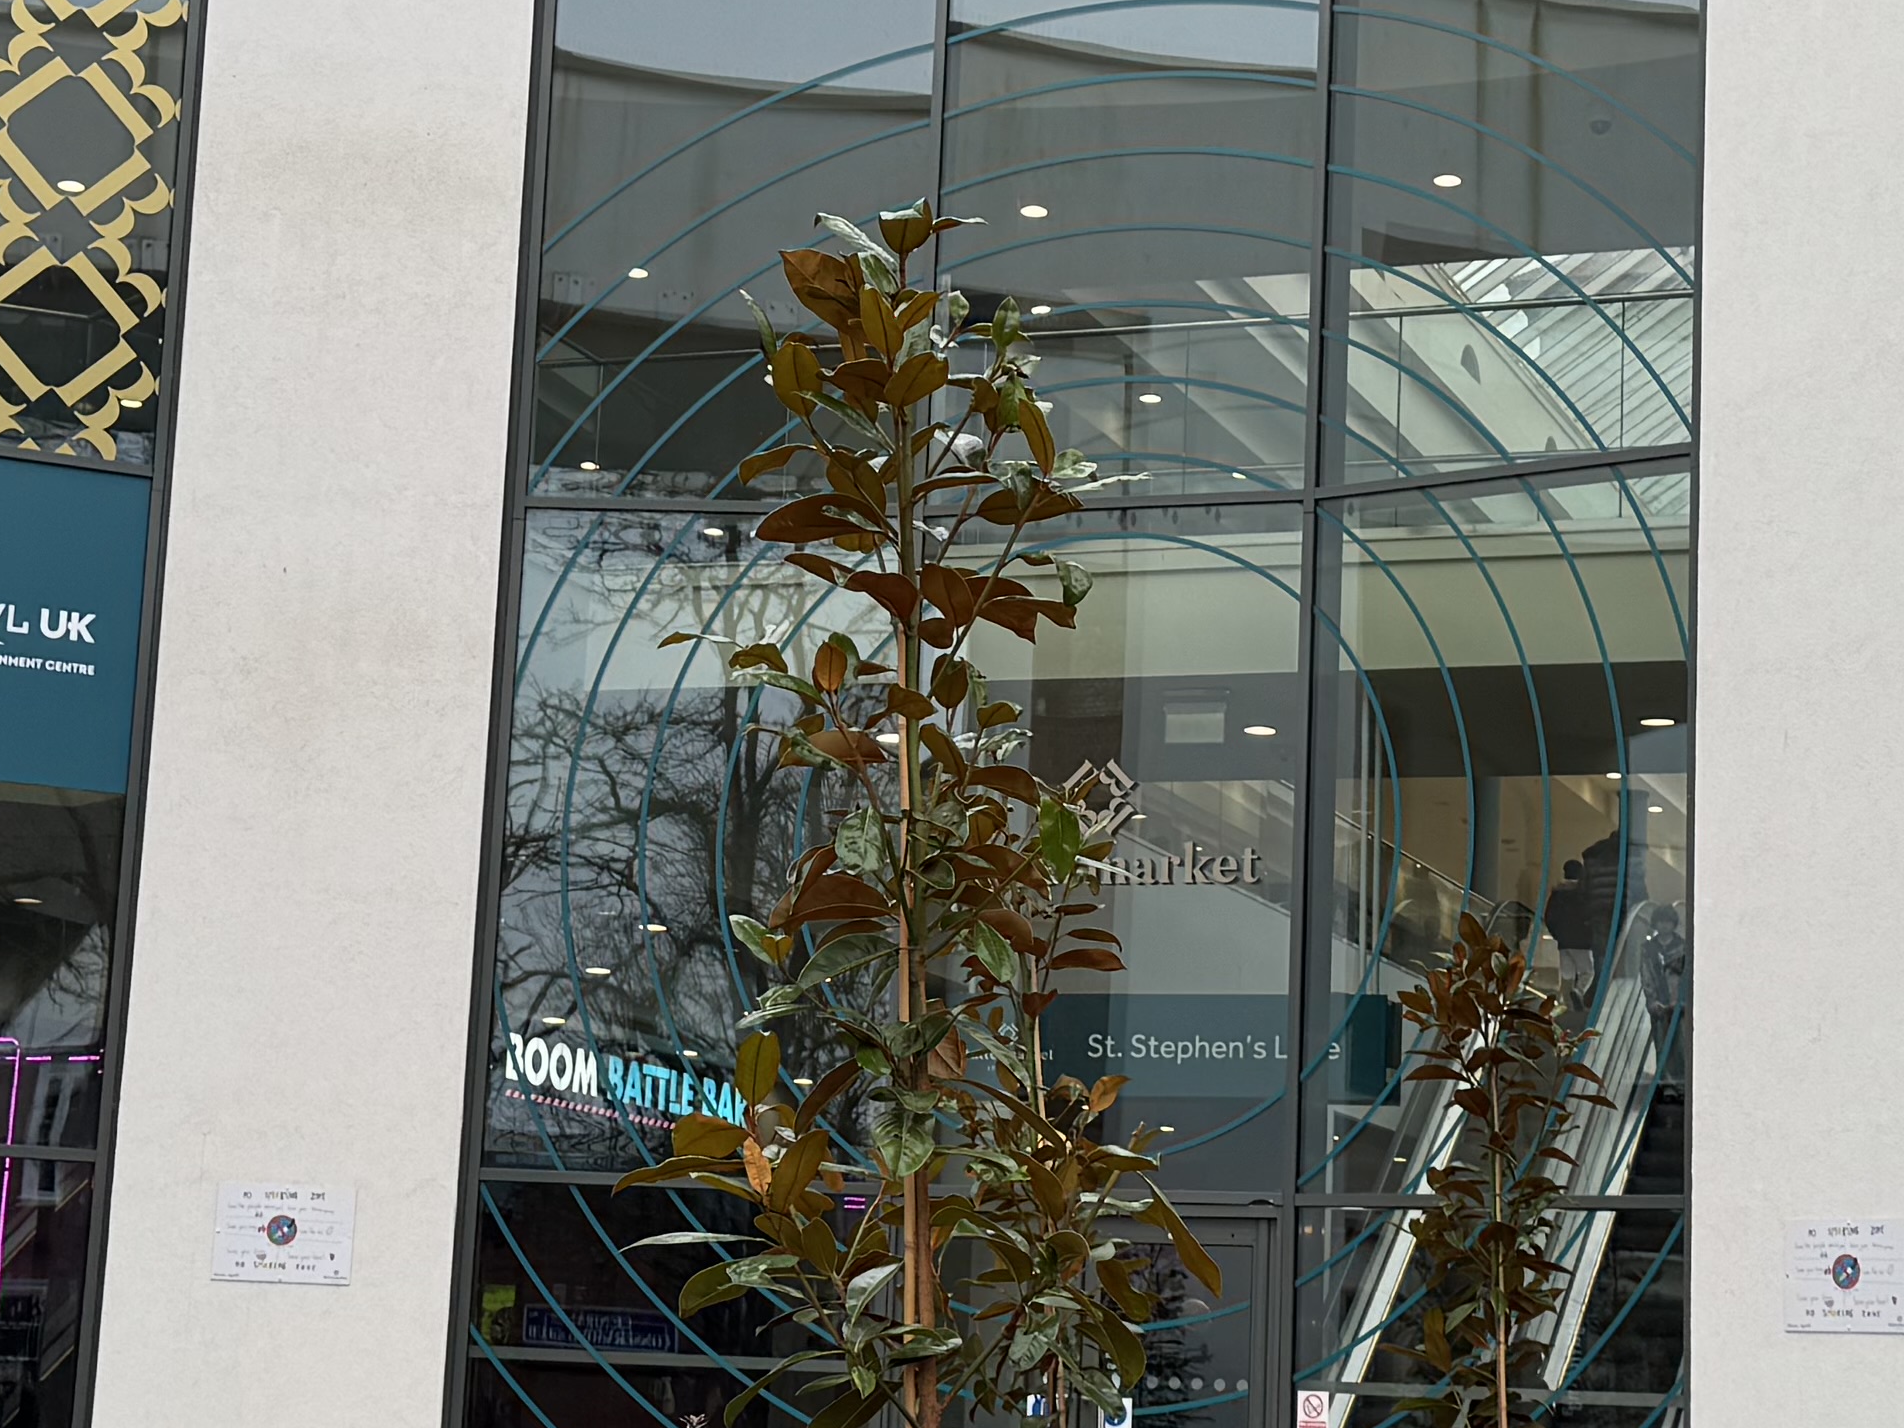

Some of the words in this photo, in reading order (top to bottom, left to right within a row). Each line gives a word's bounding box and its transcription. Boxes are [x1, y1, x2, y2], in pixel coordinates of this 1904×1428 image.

[40, 608, 96, 644] UK
[44, 659, 96, 677] CENTRE
[1087, 1033, 1123, 1059] St.
[1130, 1033, 1267, 1064] Stephen's
[1274, 1035, 1341, 1060] Le
[506, 1032, 598, 1098] BOOM
[607, 1054, 695, 1116] BATTLE
